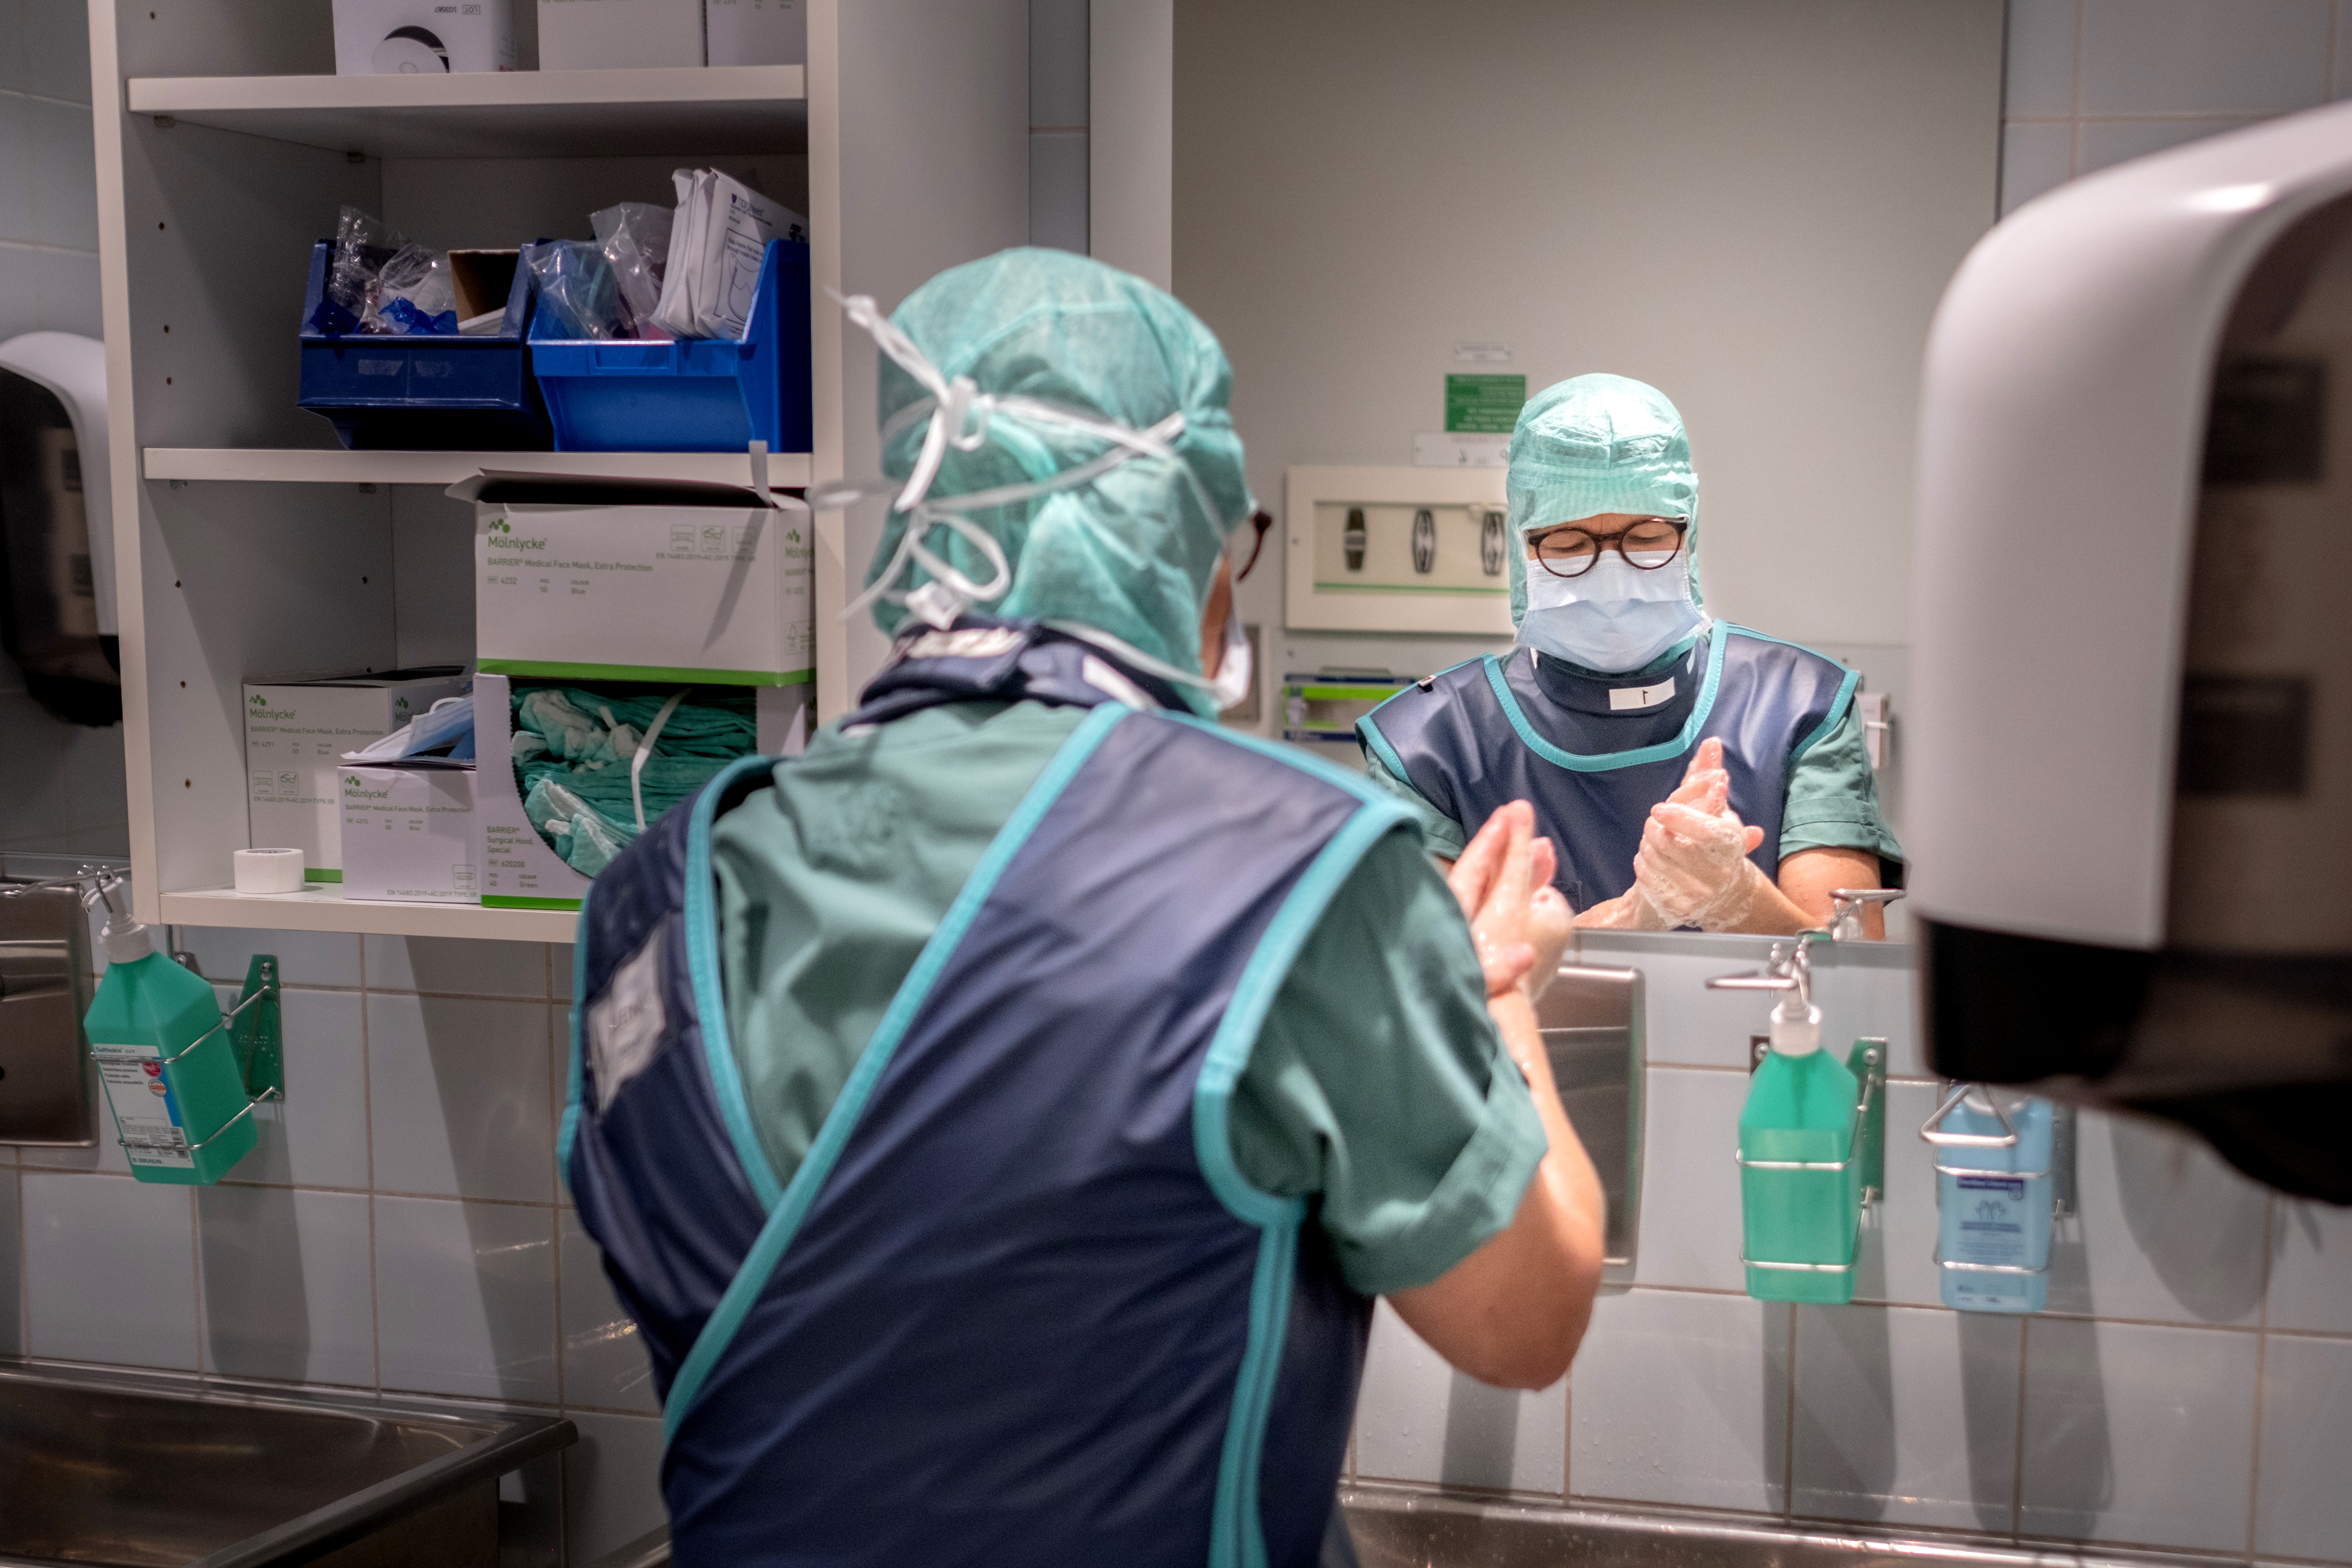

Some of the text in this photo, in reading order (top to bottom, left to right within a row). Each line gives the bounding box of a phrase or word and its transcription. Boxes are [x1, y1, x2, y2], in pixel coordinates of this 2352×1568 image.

[488, 558, 523, 566] BARRIER®
[572, 561, 592, 569] Mask,
[487, 836, 513, 845] Surgical
[488, 846, 511, 854] Special
